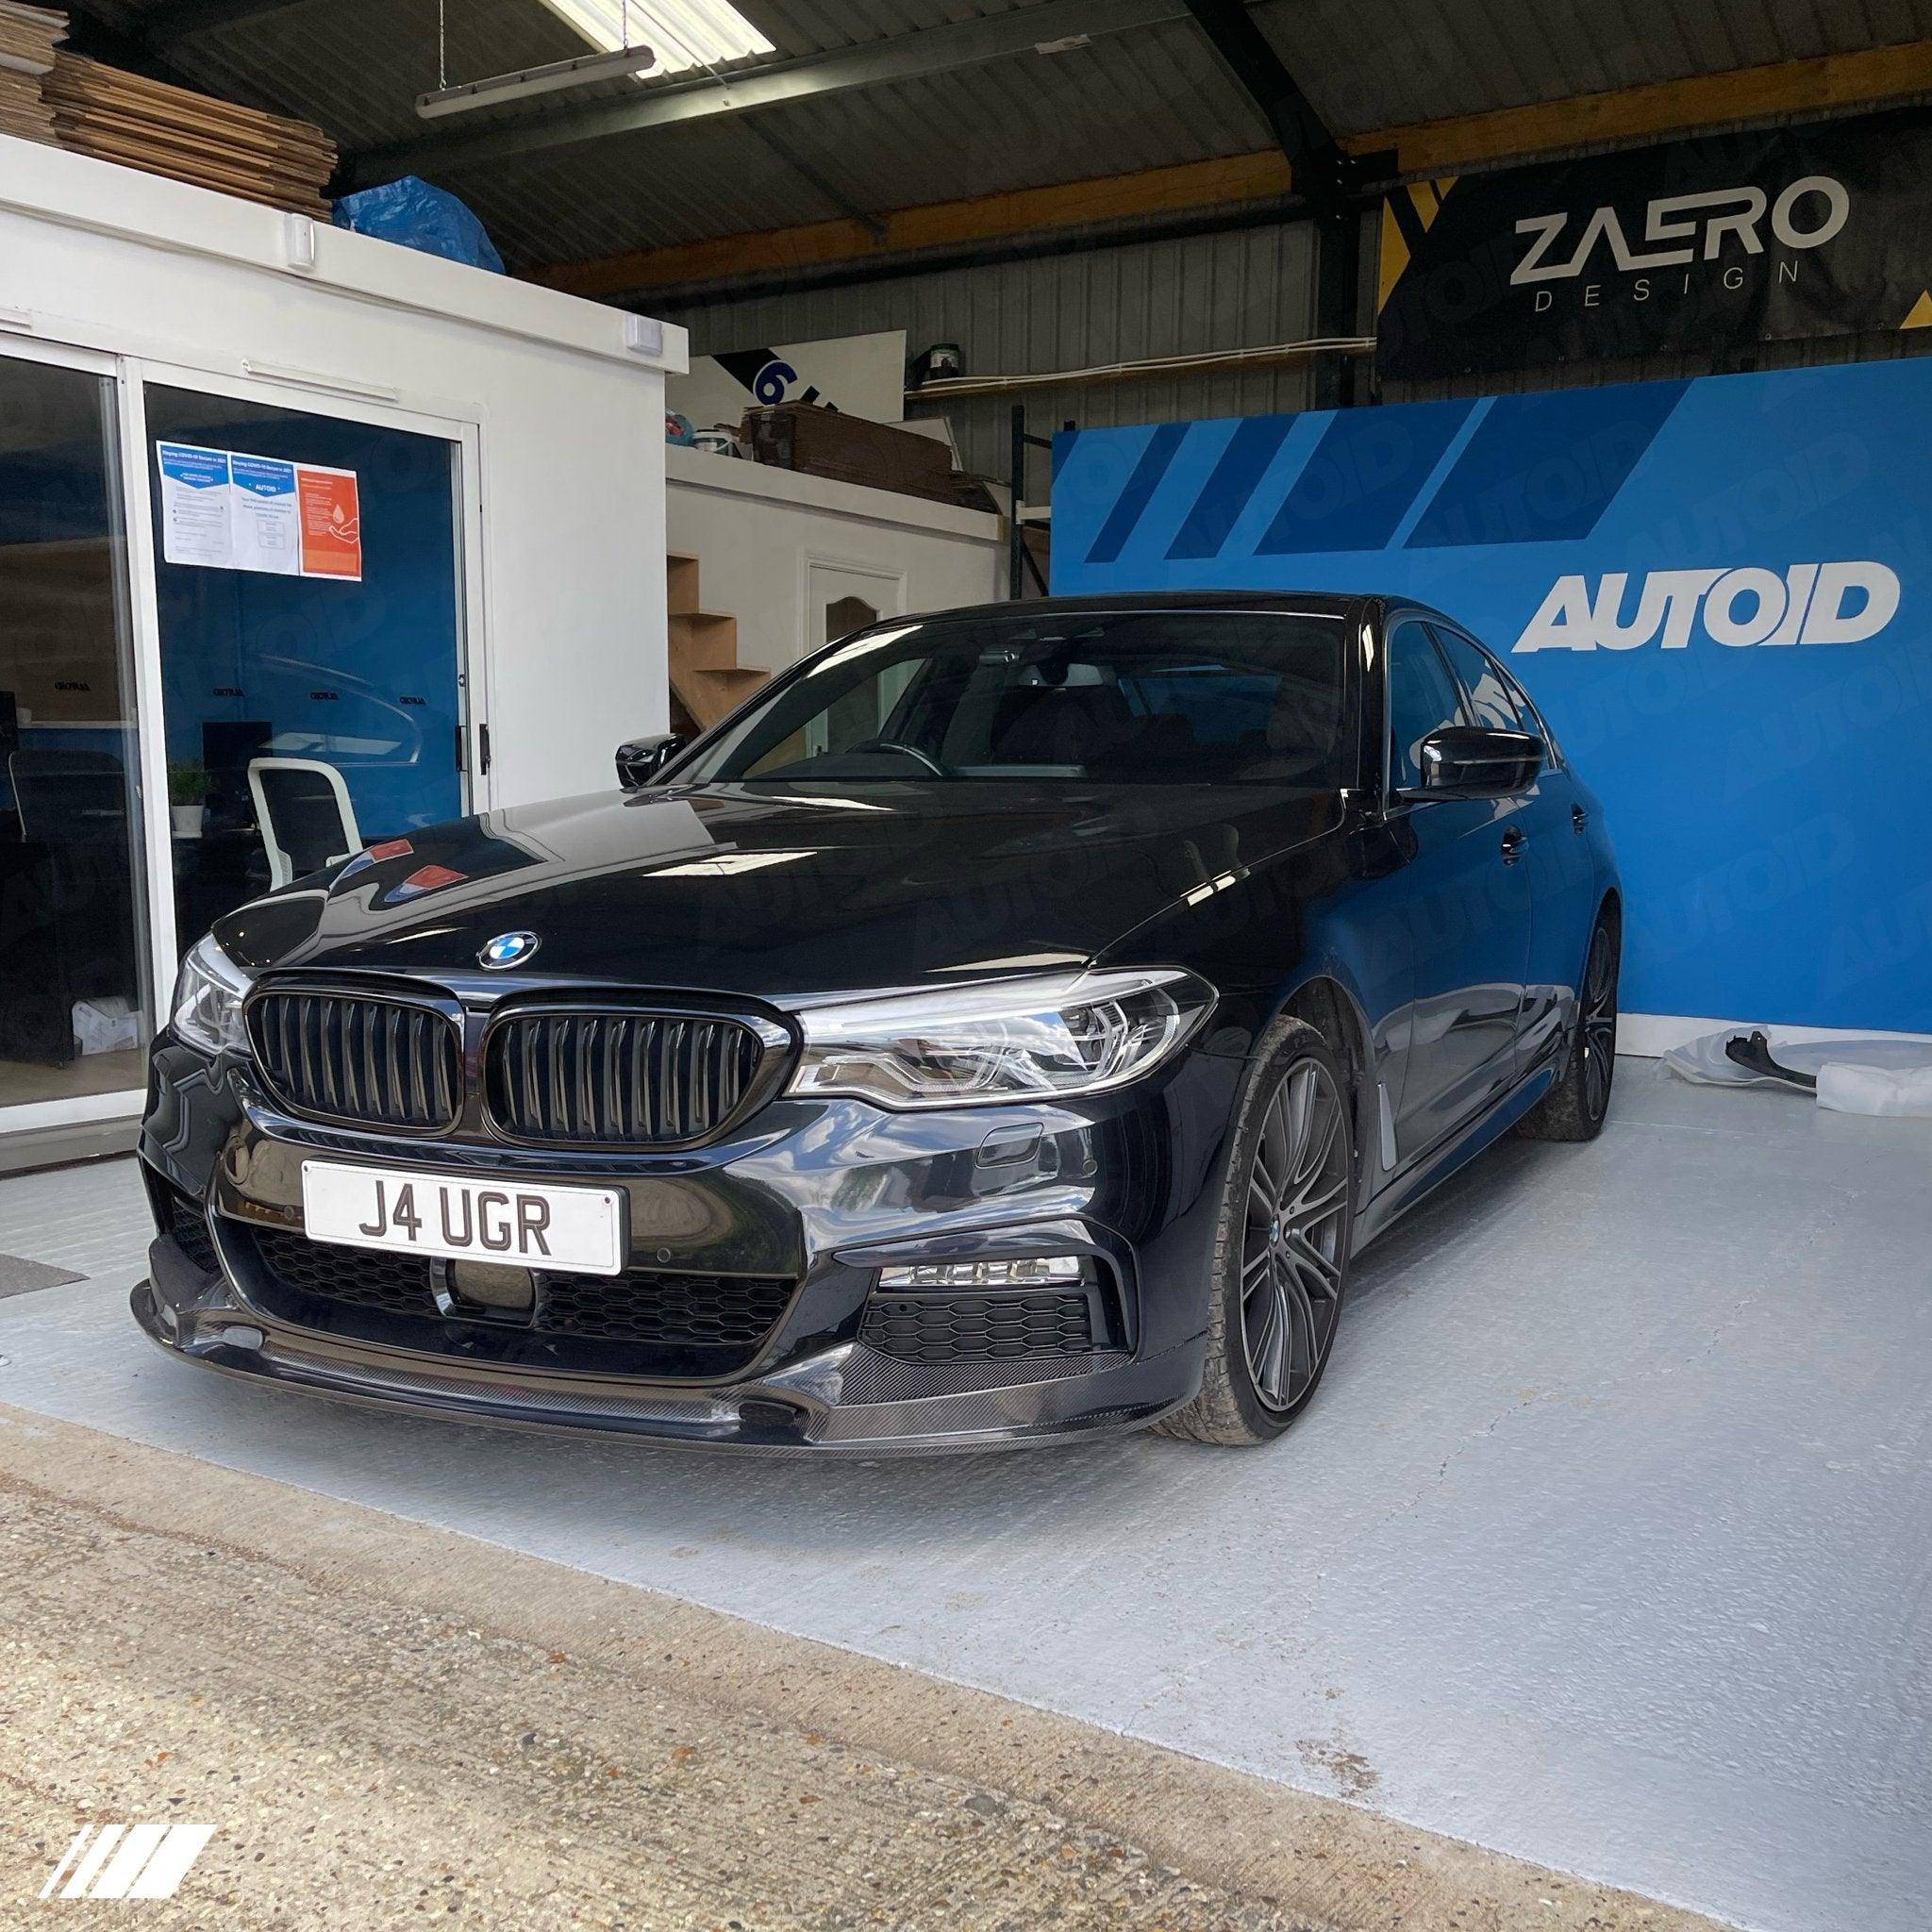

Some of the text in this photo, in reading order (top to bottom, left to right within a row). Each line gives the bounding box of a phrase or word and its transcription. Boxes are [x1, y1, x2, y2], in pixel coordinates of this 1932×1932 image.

[1510, 175, 1850, 285] ZAERO
[1534, 259, 1799, 312] DESIGN
[256, 483, 276, 492] AUTOID
[1512, 560, 1901, 652] AUTOID
[359, 1180, 552, 1256] J4 UGR
